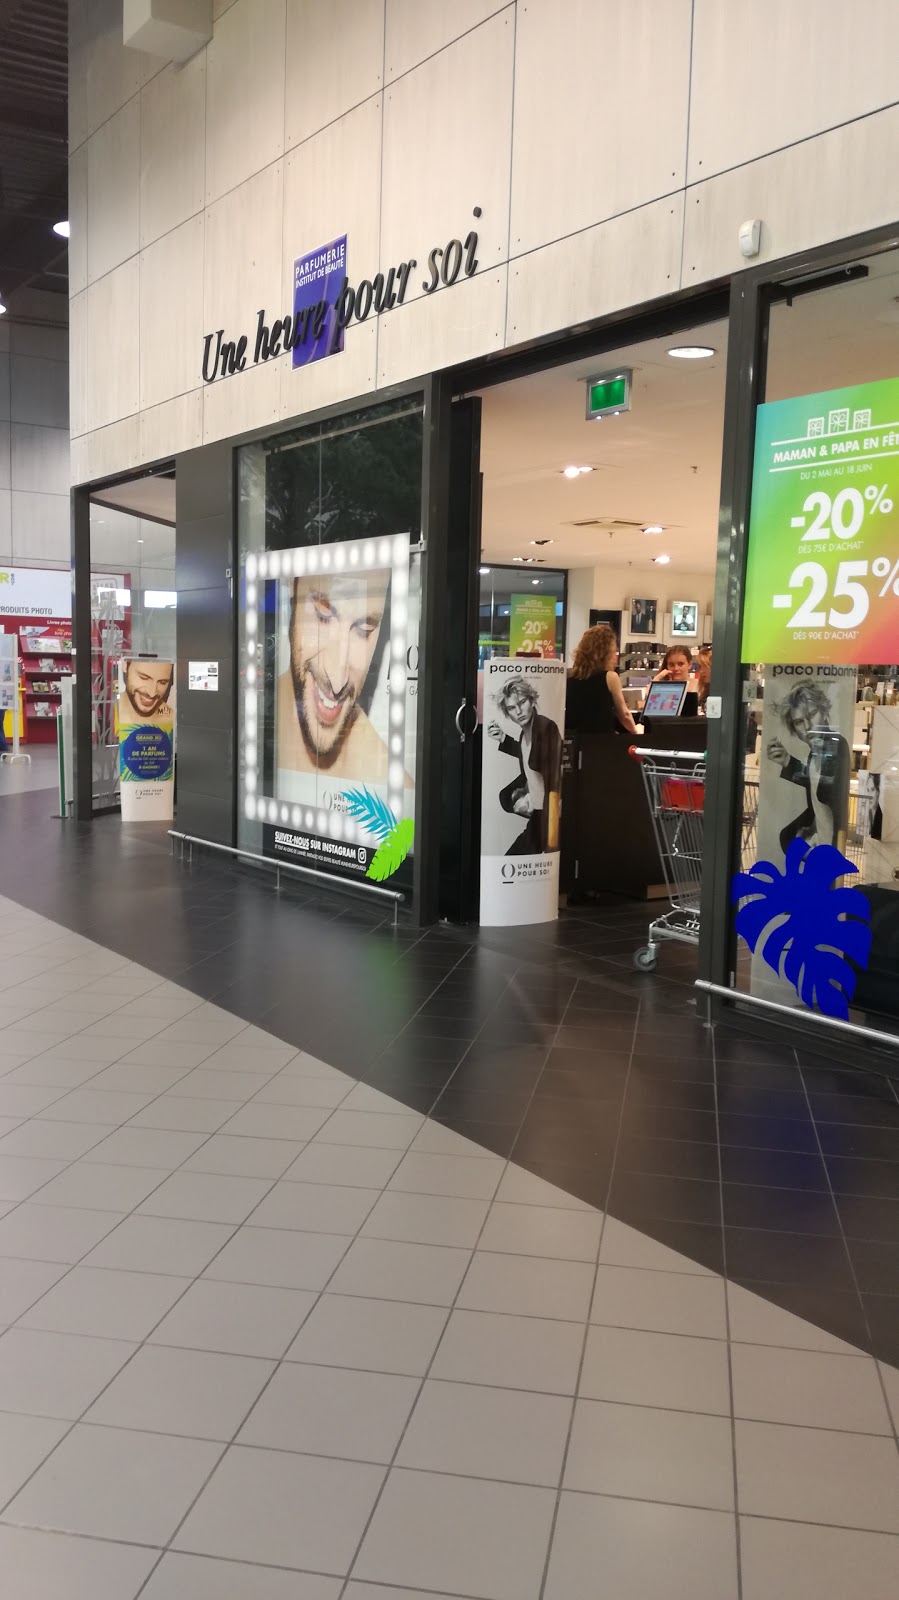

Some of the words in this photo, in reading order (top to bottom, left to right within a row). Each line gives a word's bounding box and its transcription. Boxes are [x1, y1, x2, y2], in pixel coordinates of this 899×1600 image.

[296, 244, 345, 278] PARFUMERIE
[295, 271, 317, 289] INSTITUT
[317, 267, 325, 278] DE
[325, 257, 344, 275] BEAUTÉ
[202, 330, 248, 382] Une
[253, 299, 327, 363] heure
[334, 276, 417, 354] pour
[422, 206, 482, 292] soi
[773, 447, 817, 463] MAMAN
[819, 445, 828, 456] &
[831, 440, 860, 454] PAPA
[863, 437, 879, 450] EN
[800, 472, 811, 480] DU
[812, 470, 816, 479] 2
[818, 468, 832, 478] MAI
[834, 467, 844, 475] AU
[847, 466, 855, 474] 18
[855, 464, 873, 473] JUIN
[790, 484, 894, 542] -20%
[813, 543, 827, 553] 75€
[0, 605, 30, 614] RODUITS
[31, 607, 53, 615] PHOTO
[793, 630, 806, 640] DÈS
[808, 631, 822, 640] 90€
[490, 664, 522, 674] paco
[525, 664, 565, 674] rabanne
[772, 665, 814, 677] paco
[274, 831, 310, 847] SUIVEZ-NOUS
[310, 839, 322, 851] SUR
[321, 842, 357, 859] INSTAGRAM
